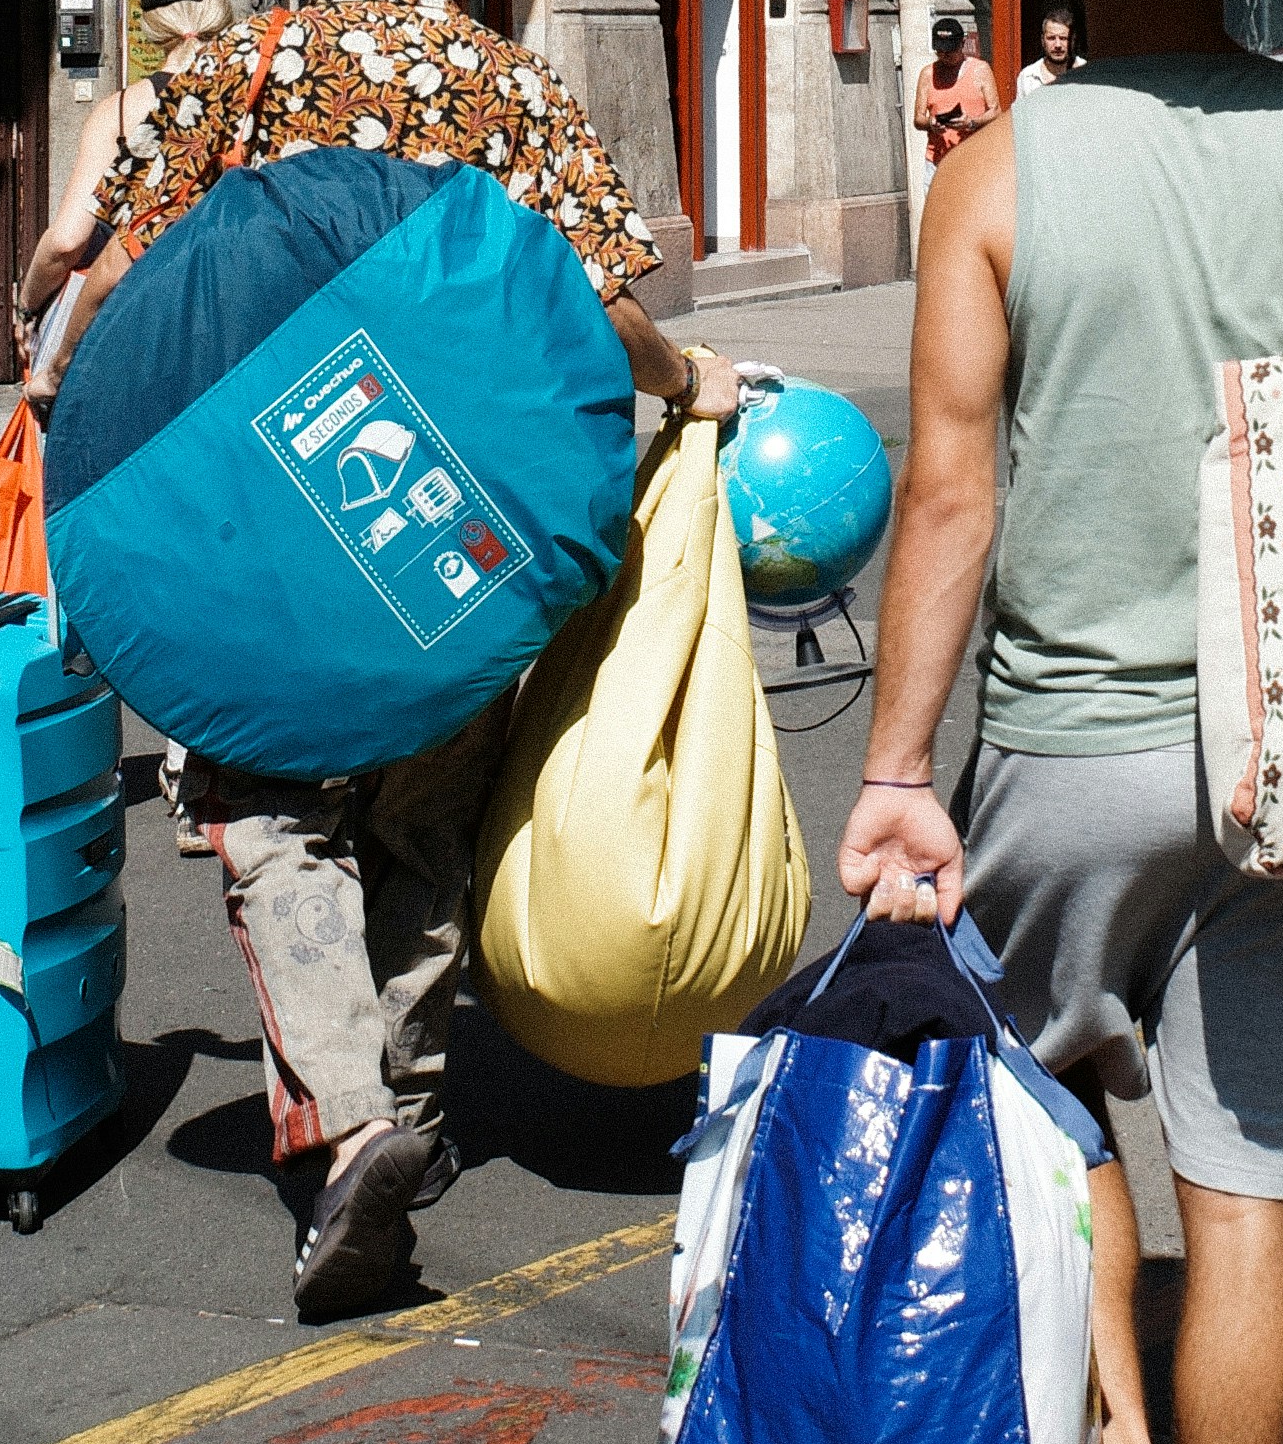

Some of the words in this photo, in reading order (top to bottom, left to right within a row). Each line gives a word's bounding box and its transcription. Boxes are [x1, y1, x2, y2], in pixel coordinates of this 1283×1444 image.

[304, 357, 364, 410] Quechua
[299, 437, 312, 453] 2
[308, 392, 363, 445] SECONDS
